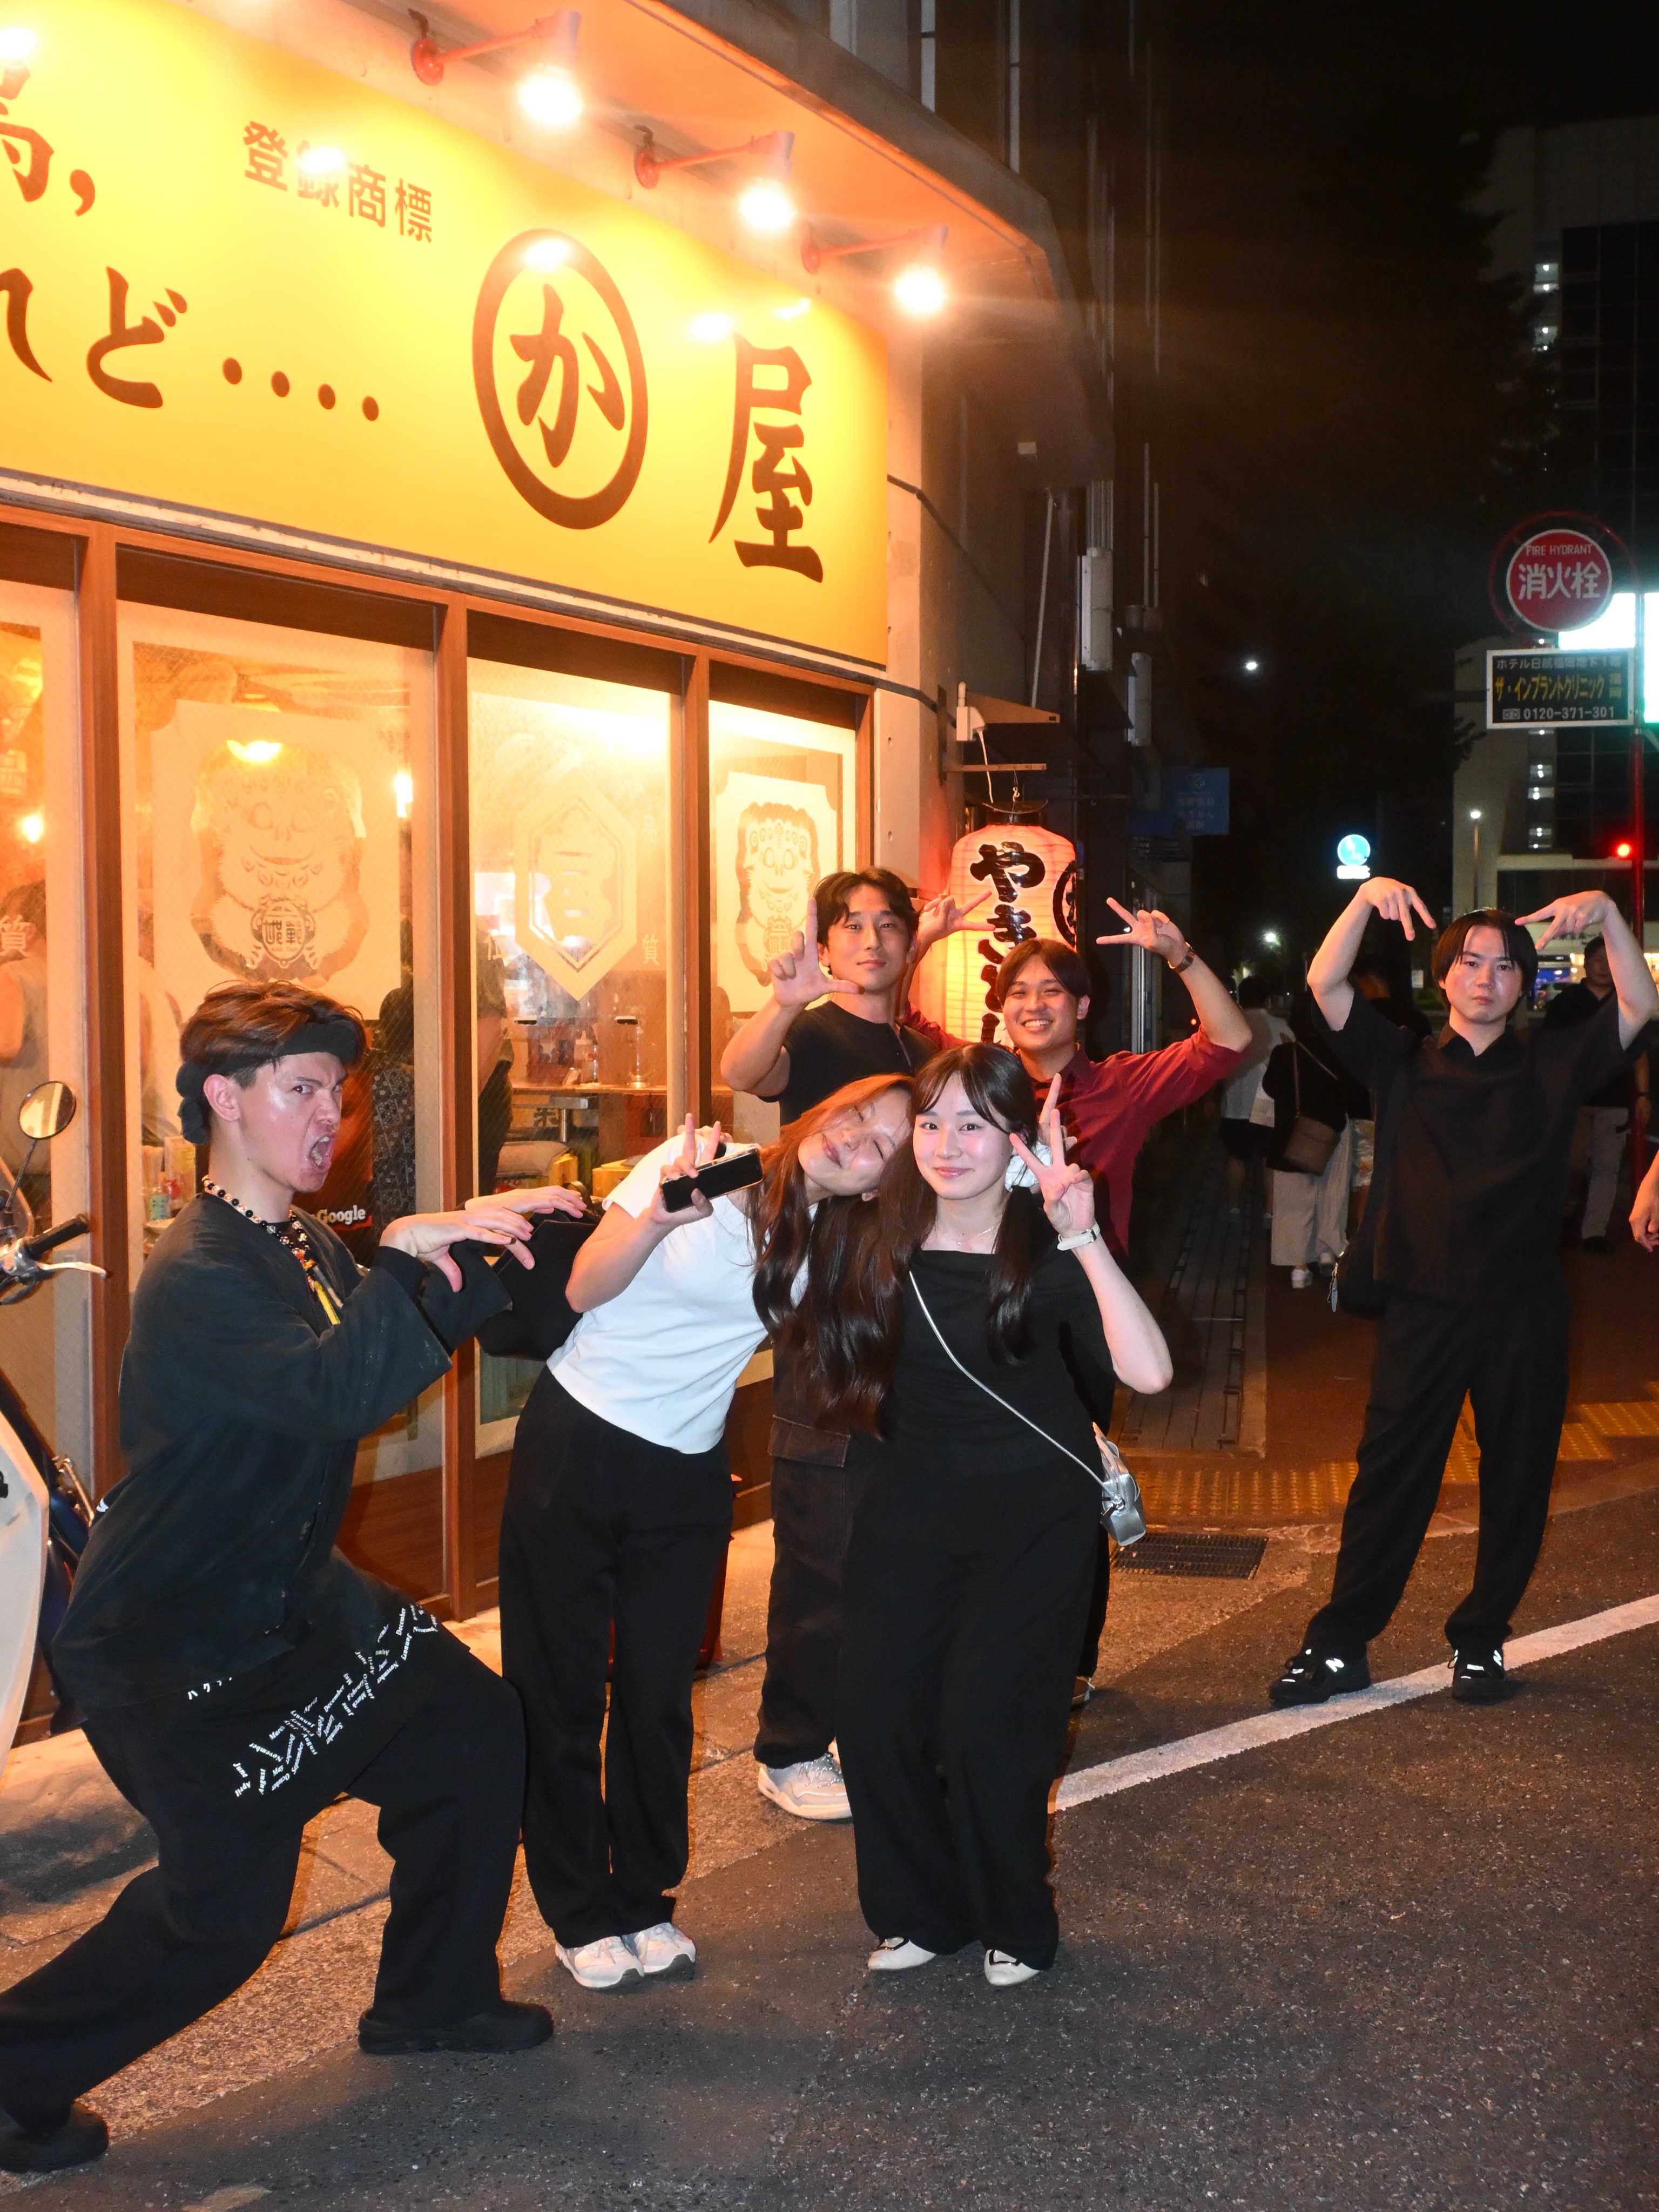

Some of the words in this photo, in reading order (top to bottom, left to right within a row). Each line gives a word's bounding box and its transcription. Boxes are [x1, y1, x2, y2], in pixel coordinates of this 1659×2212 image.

[1526, 545, 1546, 556] FIRE
[1549, 544, 1592, 555] HYDRANT
[1519, 561, 1601, 600] 消火栓
[1524, 706, 1614, 720] 0120-371-301
[316, 1205, 366, 1225] Google
[396, 1608, 406, 1636] December
[401, 1633, 412, 1661] January
[355, 1651, 367, 1664] June
[343, 1673, 353, 1685] May
[377, 1661, 399, 1684] November
[363, 1674, 375, 1699] October
[304, 1697, 318, 1713] April
[324, 1685, 345, 1712] December
[352, 1691, 366, 1709] March
[342, 1702, 355, 1716] June
[291, 1710, 315, 1728] January
[249, 1743, 284, 1762] November
[286, 1734, 296, 1765] December
[301, 1733, 318, 1755] August
[292, 1741, 304, 1775] September
[233, 1763, 248, 1778] June
[272, 1765, 284, 1777] May
[234, 1781, 251, 1797] April
[259, 1768, 267, 1795] August
[272, 1773, 291, 1791] October
